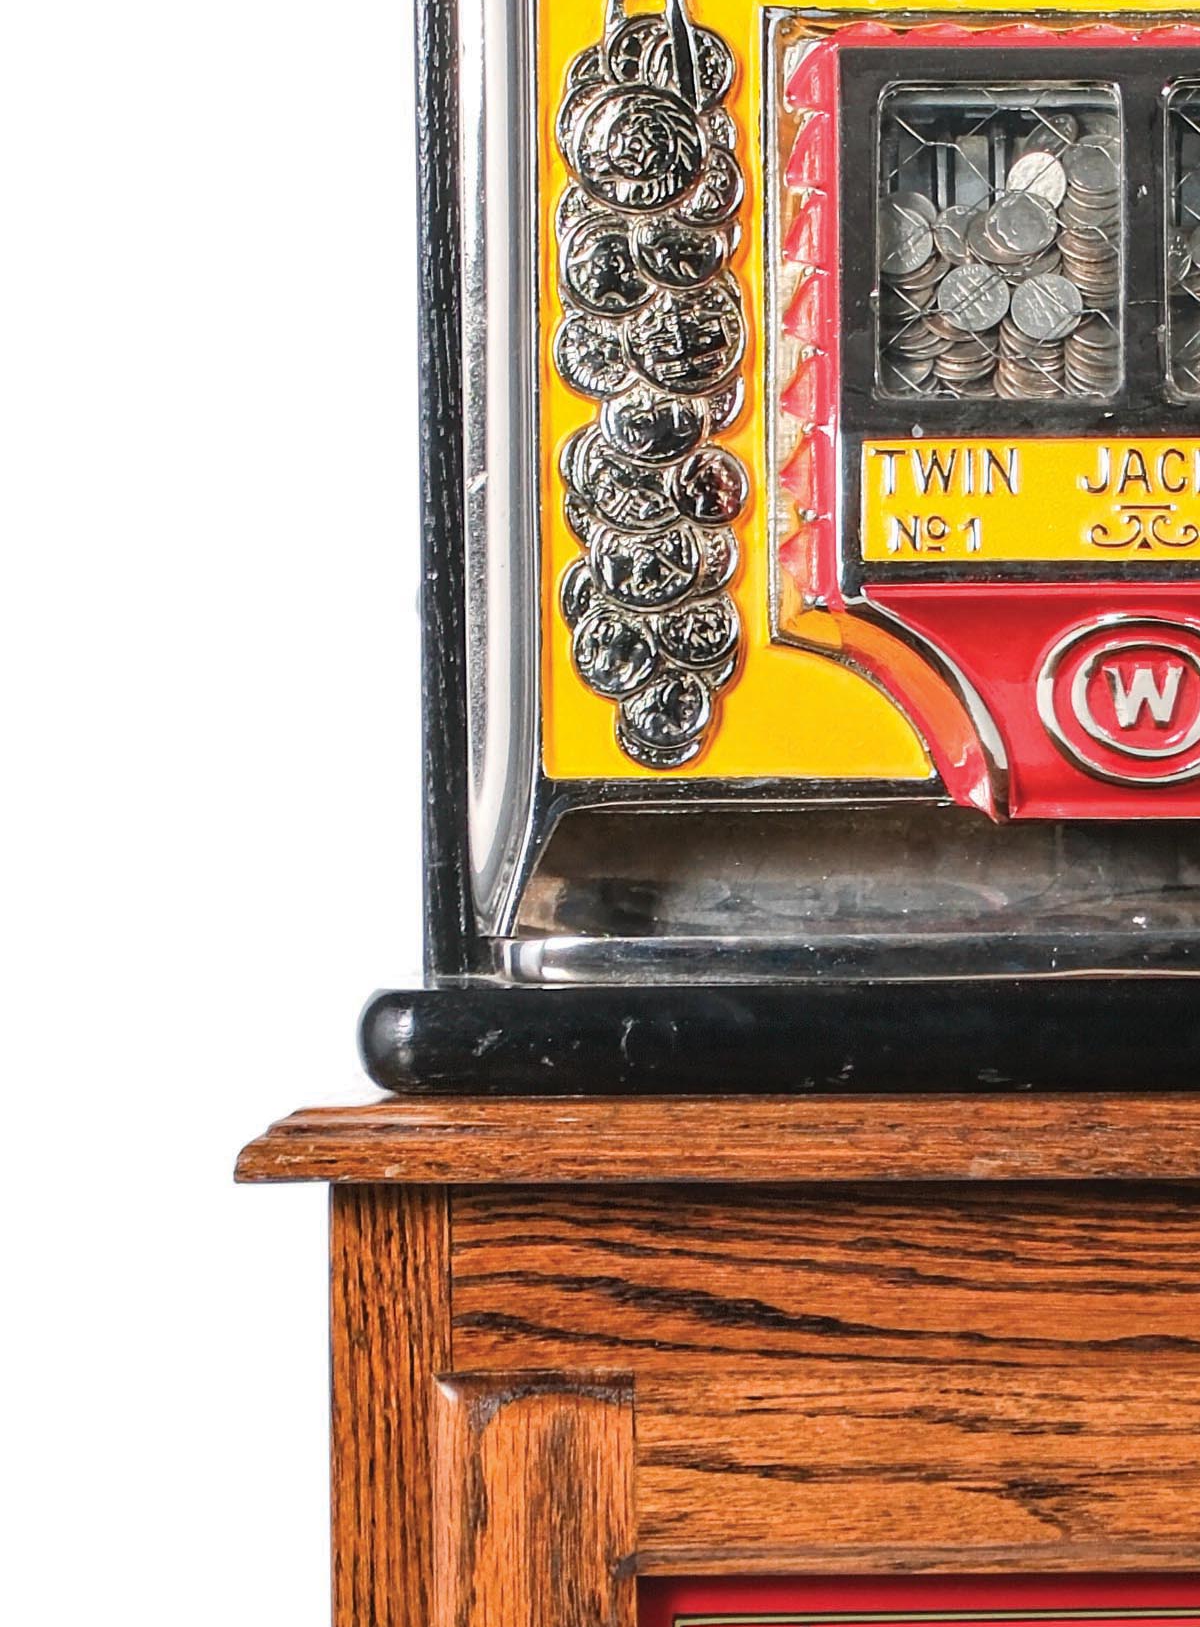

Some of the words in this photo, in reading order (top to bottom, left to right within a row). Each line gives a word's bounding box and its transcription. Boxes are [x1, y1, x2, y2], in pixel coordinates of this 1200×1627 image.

[872, 446, 1020, 496] TWIN
[961, 514, 982, 551] 1
[1104, 665, 1185, 730] W
